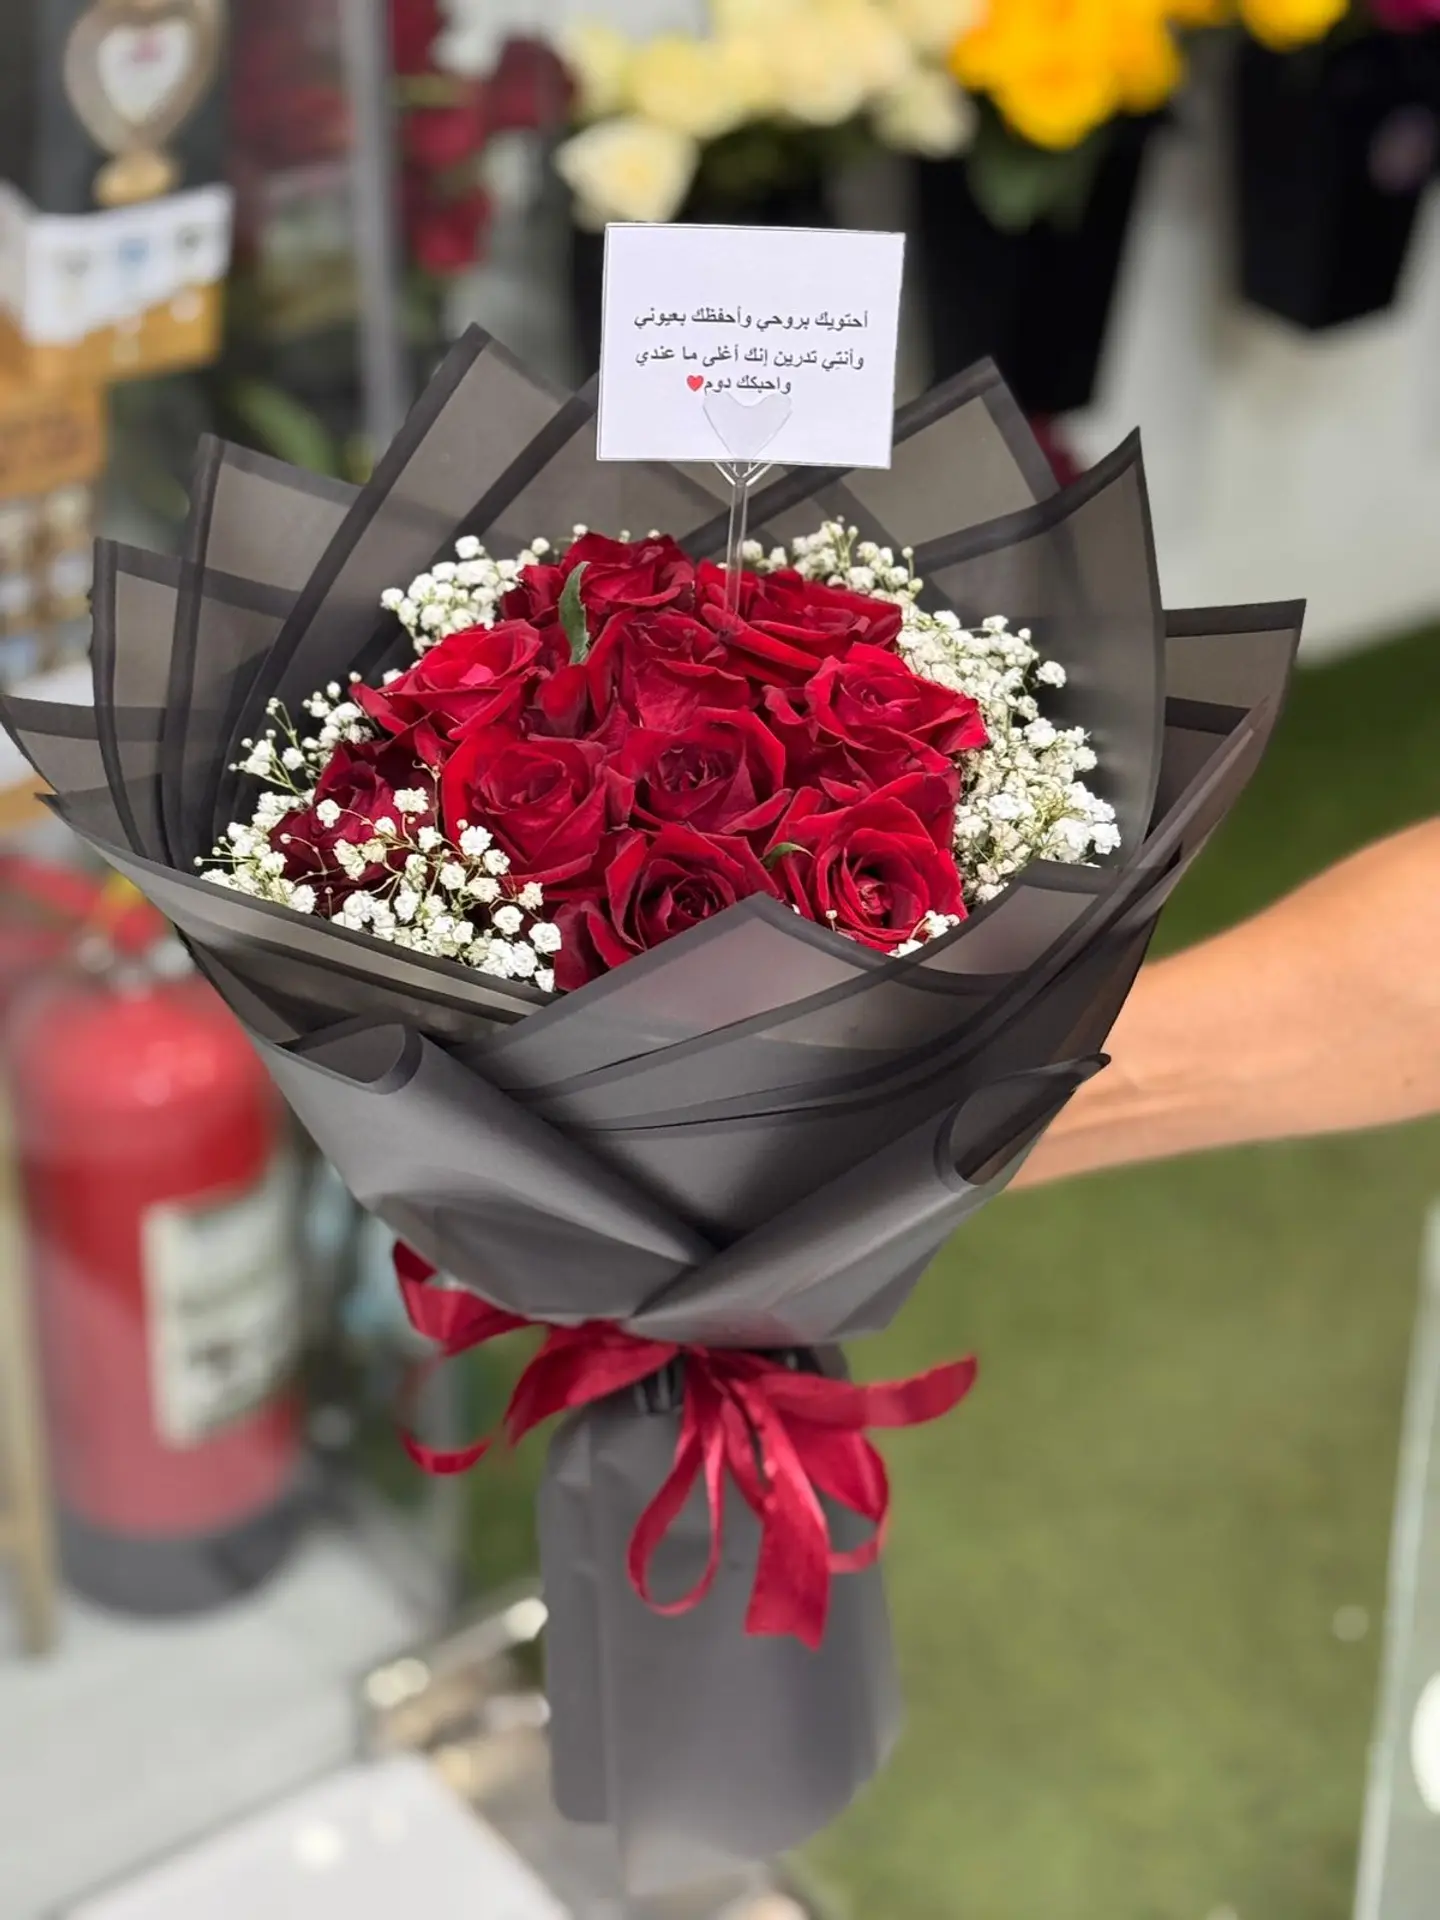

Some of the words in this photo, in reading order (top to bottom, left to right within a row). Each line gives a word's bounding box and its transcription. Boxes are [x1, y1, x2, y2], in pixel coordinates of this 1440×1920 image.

[633, 307, 687, 328] بعيوني
[691, 306, 752, 328] وأحفظك
[756, 314, 810, 332] بروحي
[635, 345, 675, 364] عندي
[682, 346, 698, 361] ما
[702, 345, 739, 367] أغلى
[744, 347, 768, 367] إنك
[773, 351, 818, 368] تدرين
